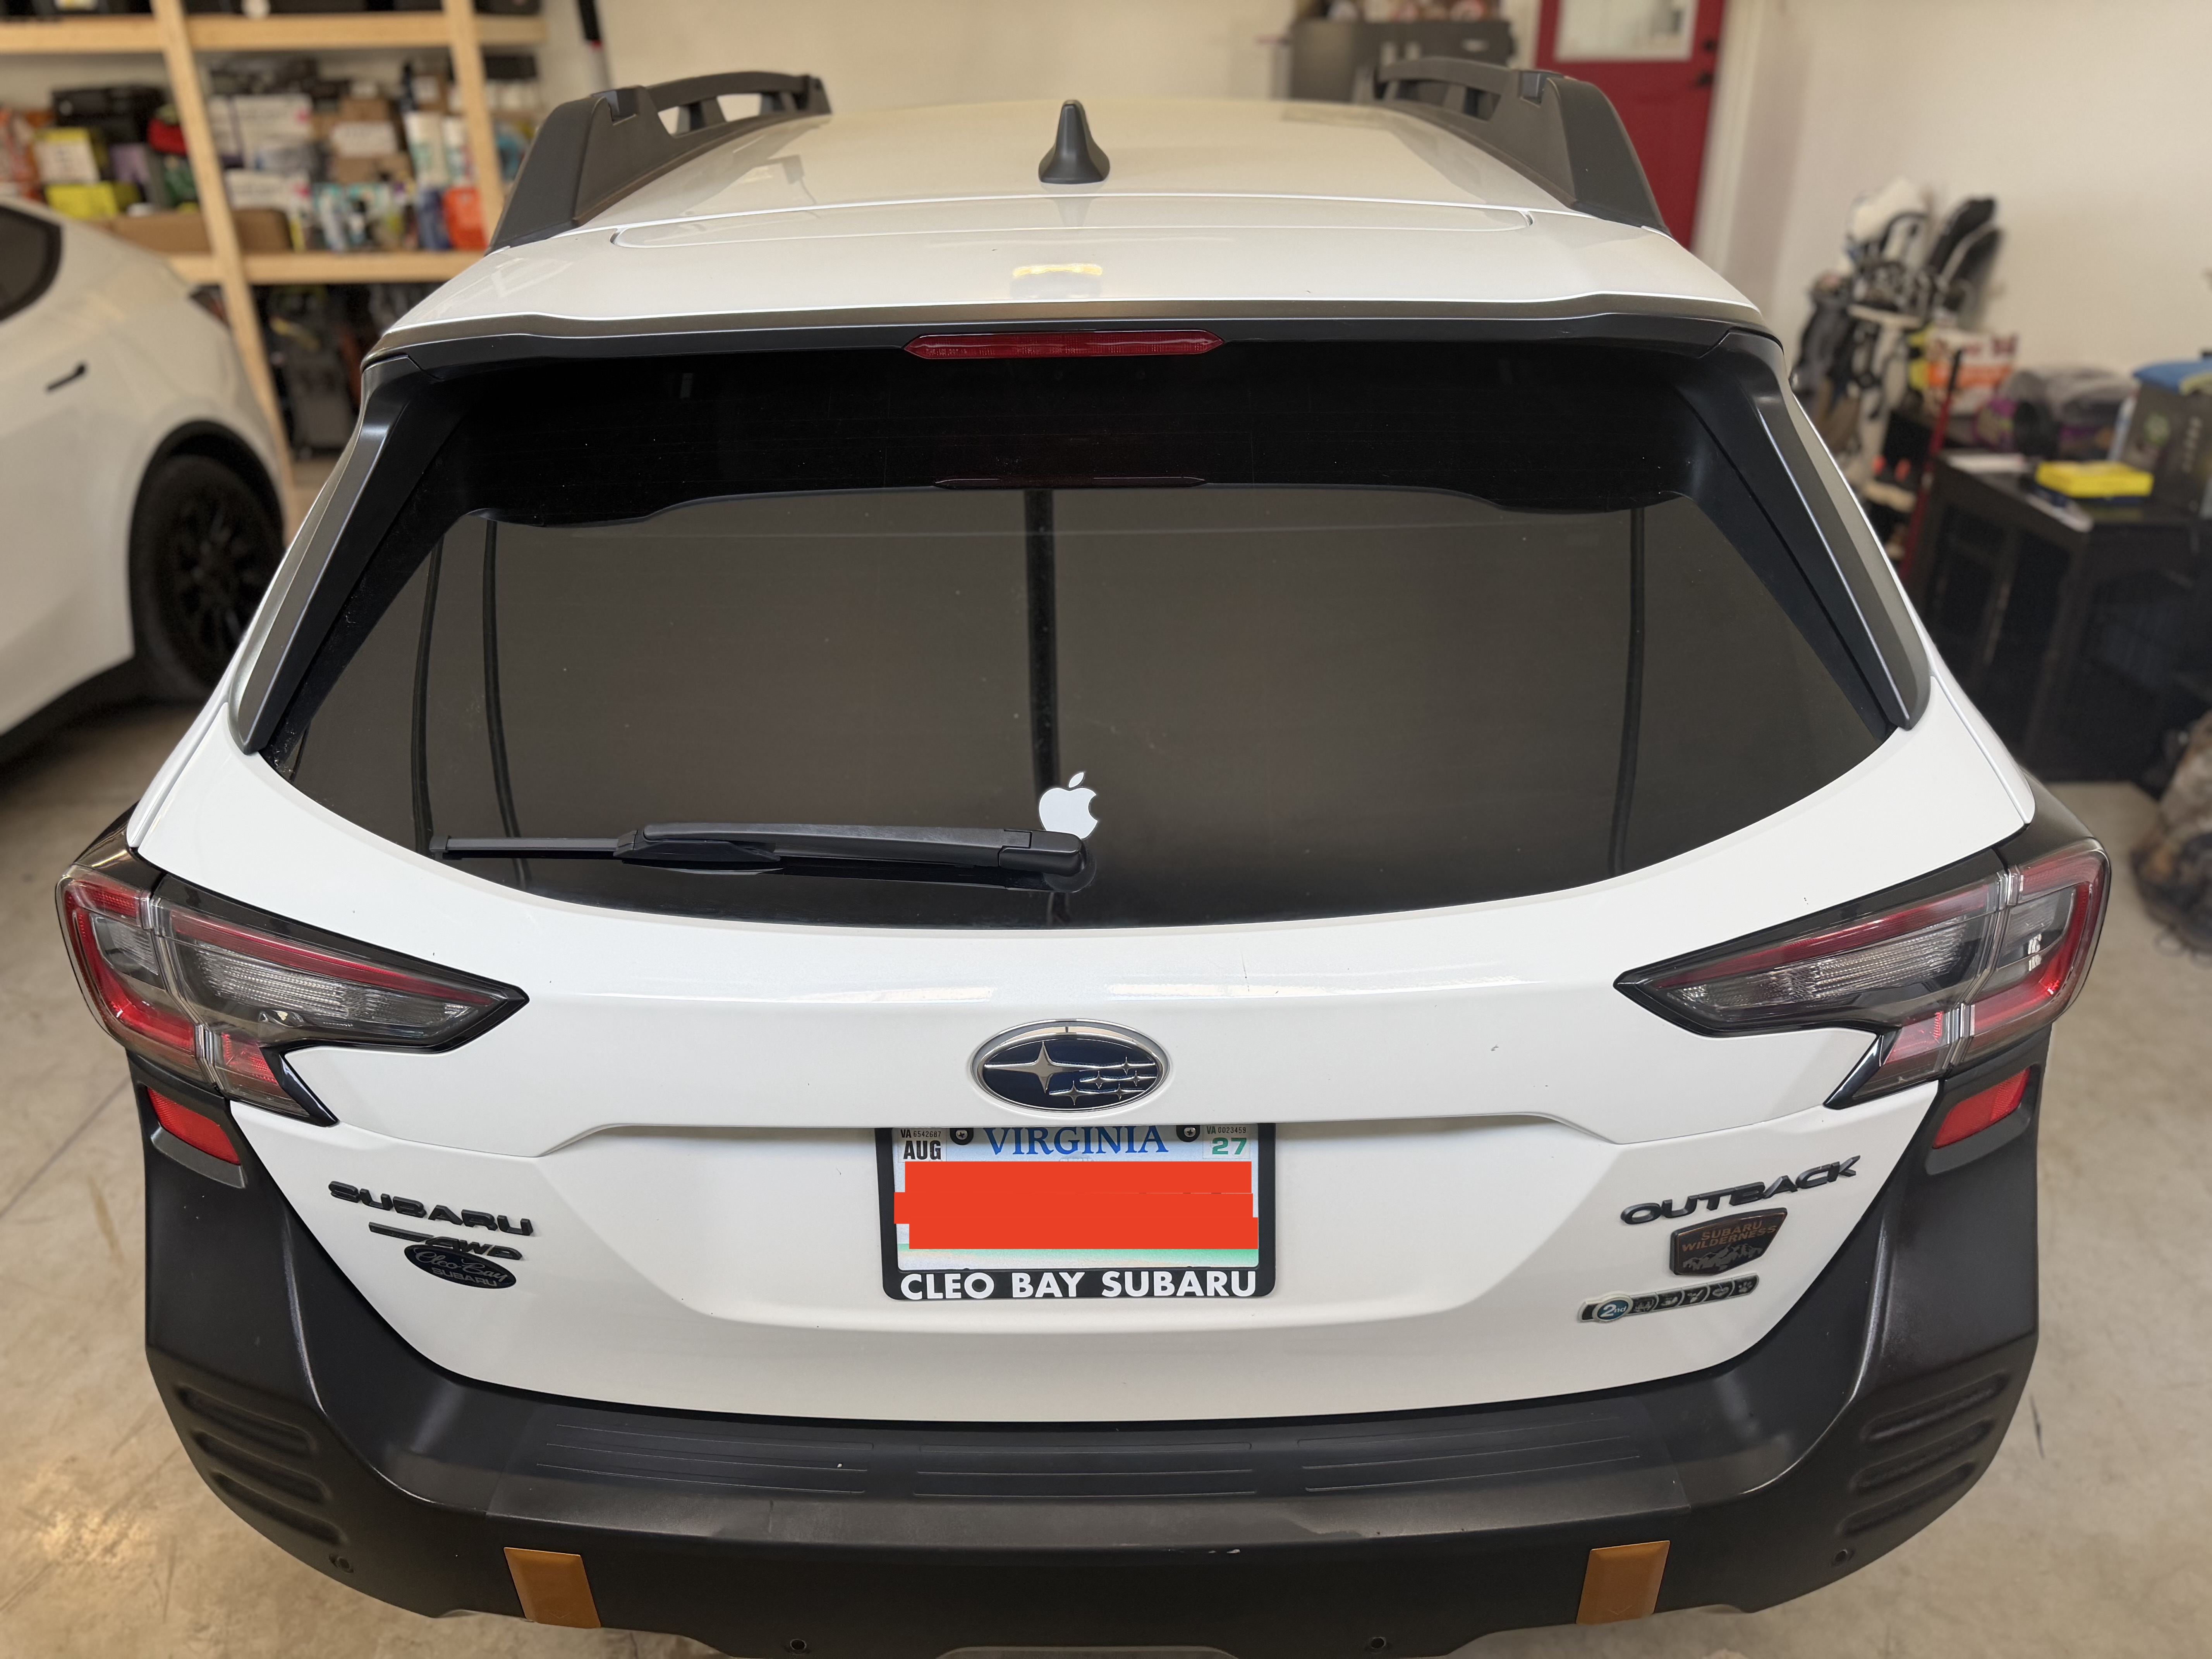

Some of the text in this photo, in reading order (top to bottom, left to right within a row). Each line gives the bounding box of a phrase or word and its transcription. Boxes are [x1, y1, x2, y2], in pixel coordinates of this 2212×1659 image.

[901, 1129, 912, 1138] VA
[983, 1126, 1169, 1155] VIRGINIA
[1206, 1126, 1216, 1134] VA
[903, 1140, 941, 1160] AUG
[1212, 1137, 1247, 1155] 27
[1620, 1155, 1861, 1224] OUTBACK
[328, 1181, 534, 1236] SUBARU
[1682, 1226, 1777, 1252] WILDERNESS
[1701, 1220, 1762, 1240] SUBARU
[413, 1247, 462, 1269] Cleo
[425, 1237, 523, 1260] AWD
[431, 1267, 497, 1286] SUBARU
[901, 1271, 1256, 1299] CLEO BAY SUBARU
[1600, 1304, 1627, 1317] 2nd
